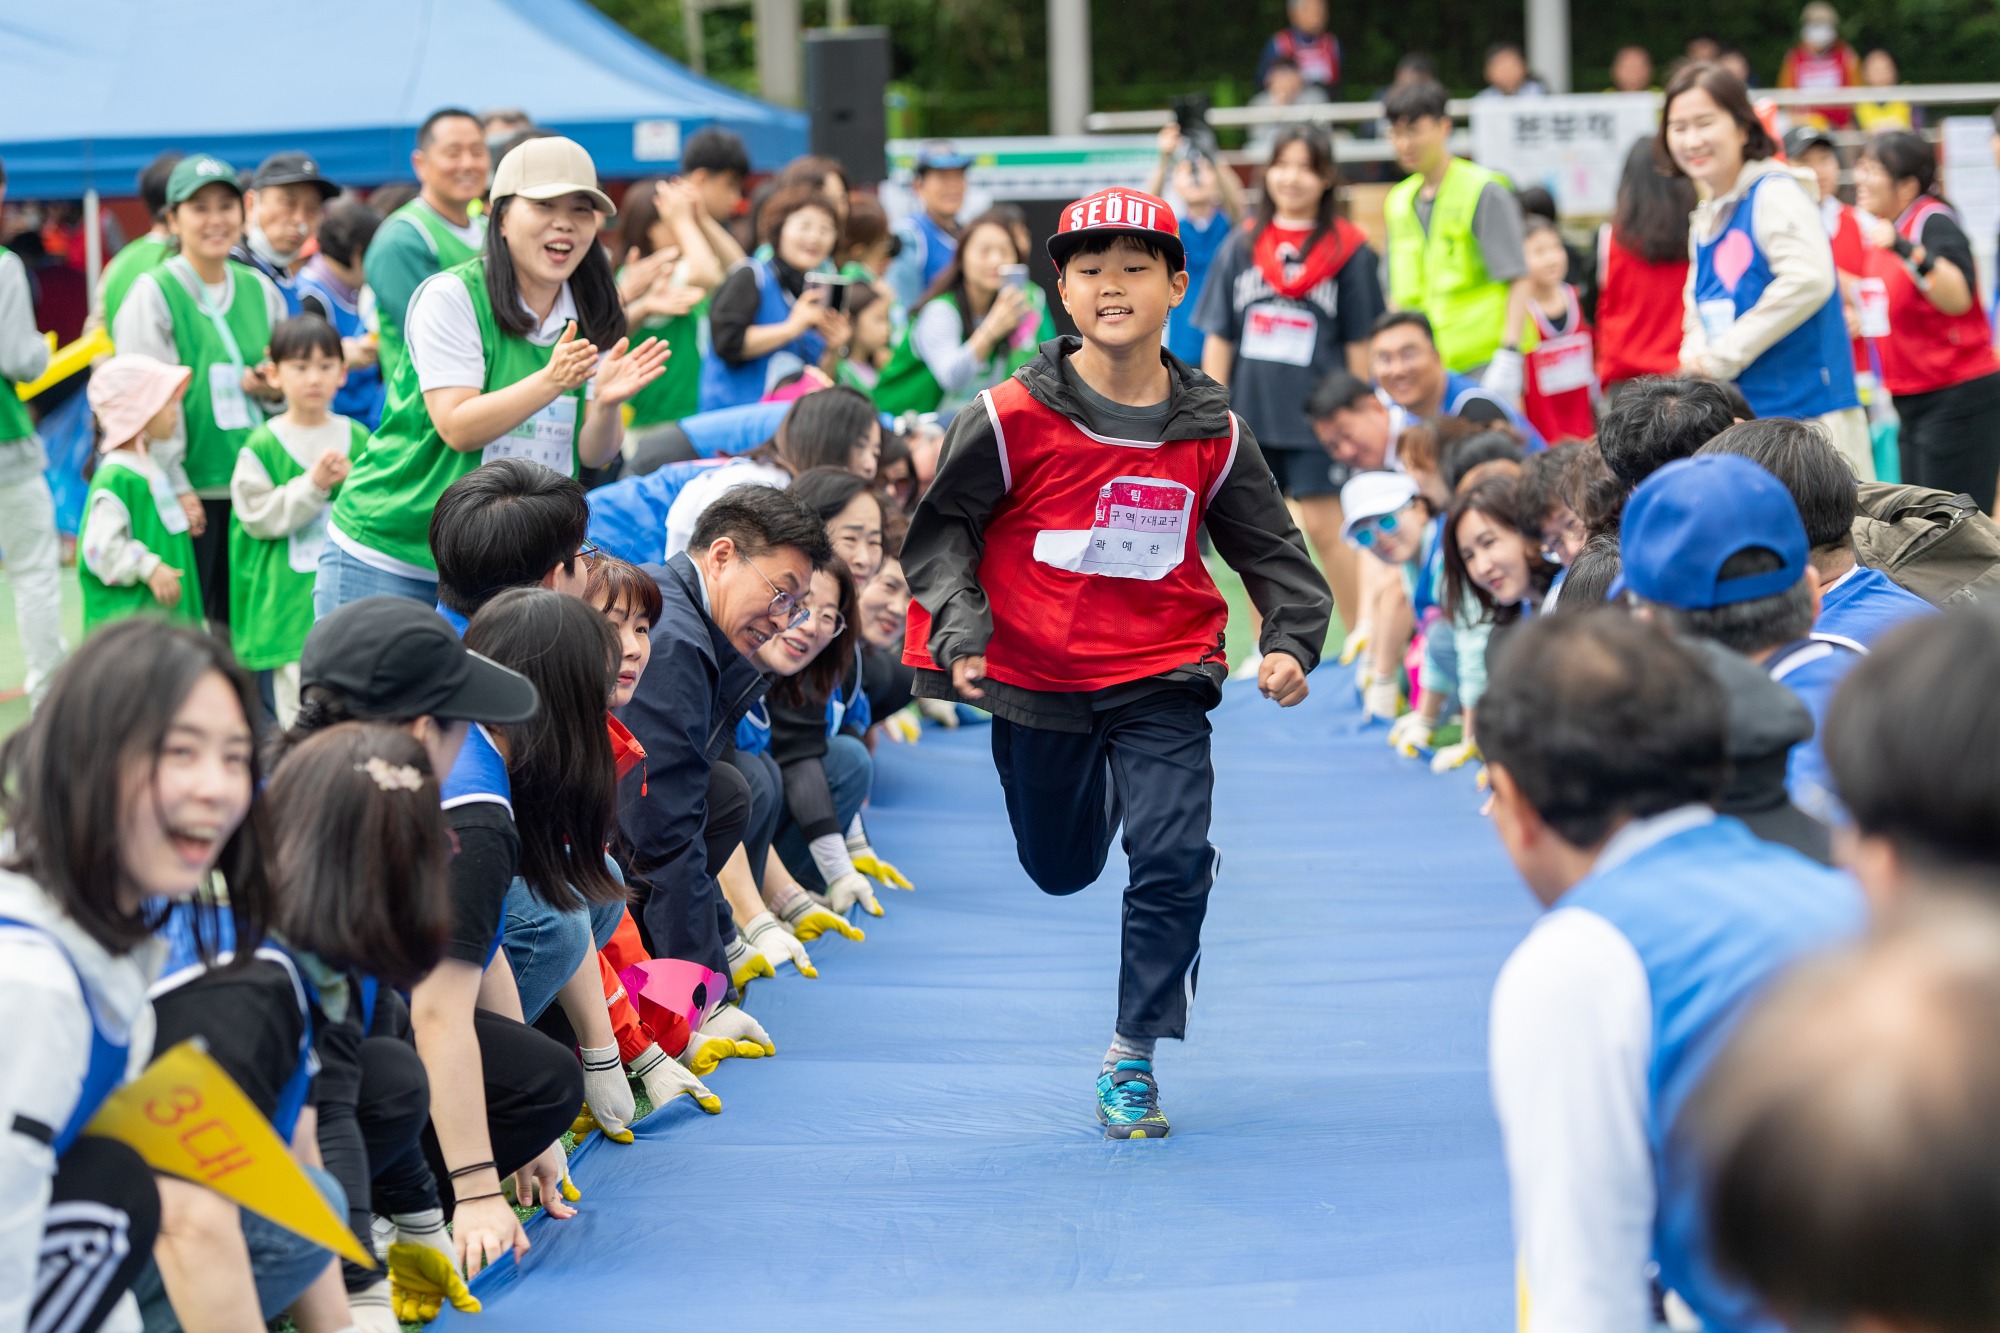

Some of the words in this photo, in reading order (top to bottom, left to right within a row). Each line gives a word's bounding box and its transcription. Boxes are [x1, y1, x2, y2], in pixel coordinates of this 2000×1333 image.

[1071, 198, 1156, 231] SEOUL
[1131, 489, 1141, 502] 팀
[1140, 515, 1178, 526] 7대교구
[1095, 539, 1106, 550] 곽
[1122, 540, 1132, 552] 예
[1150, 544, 1159, 555] 찬
